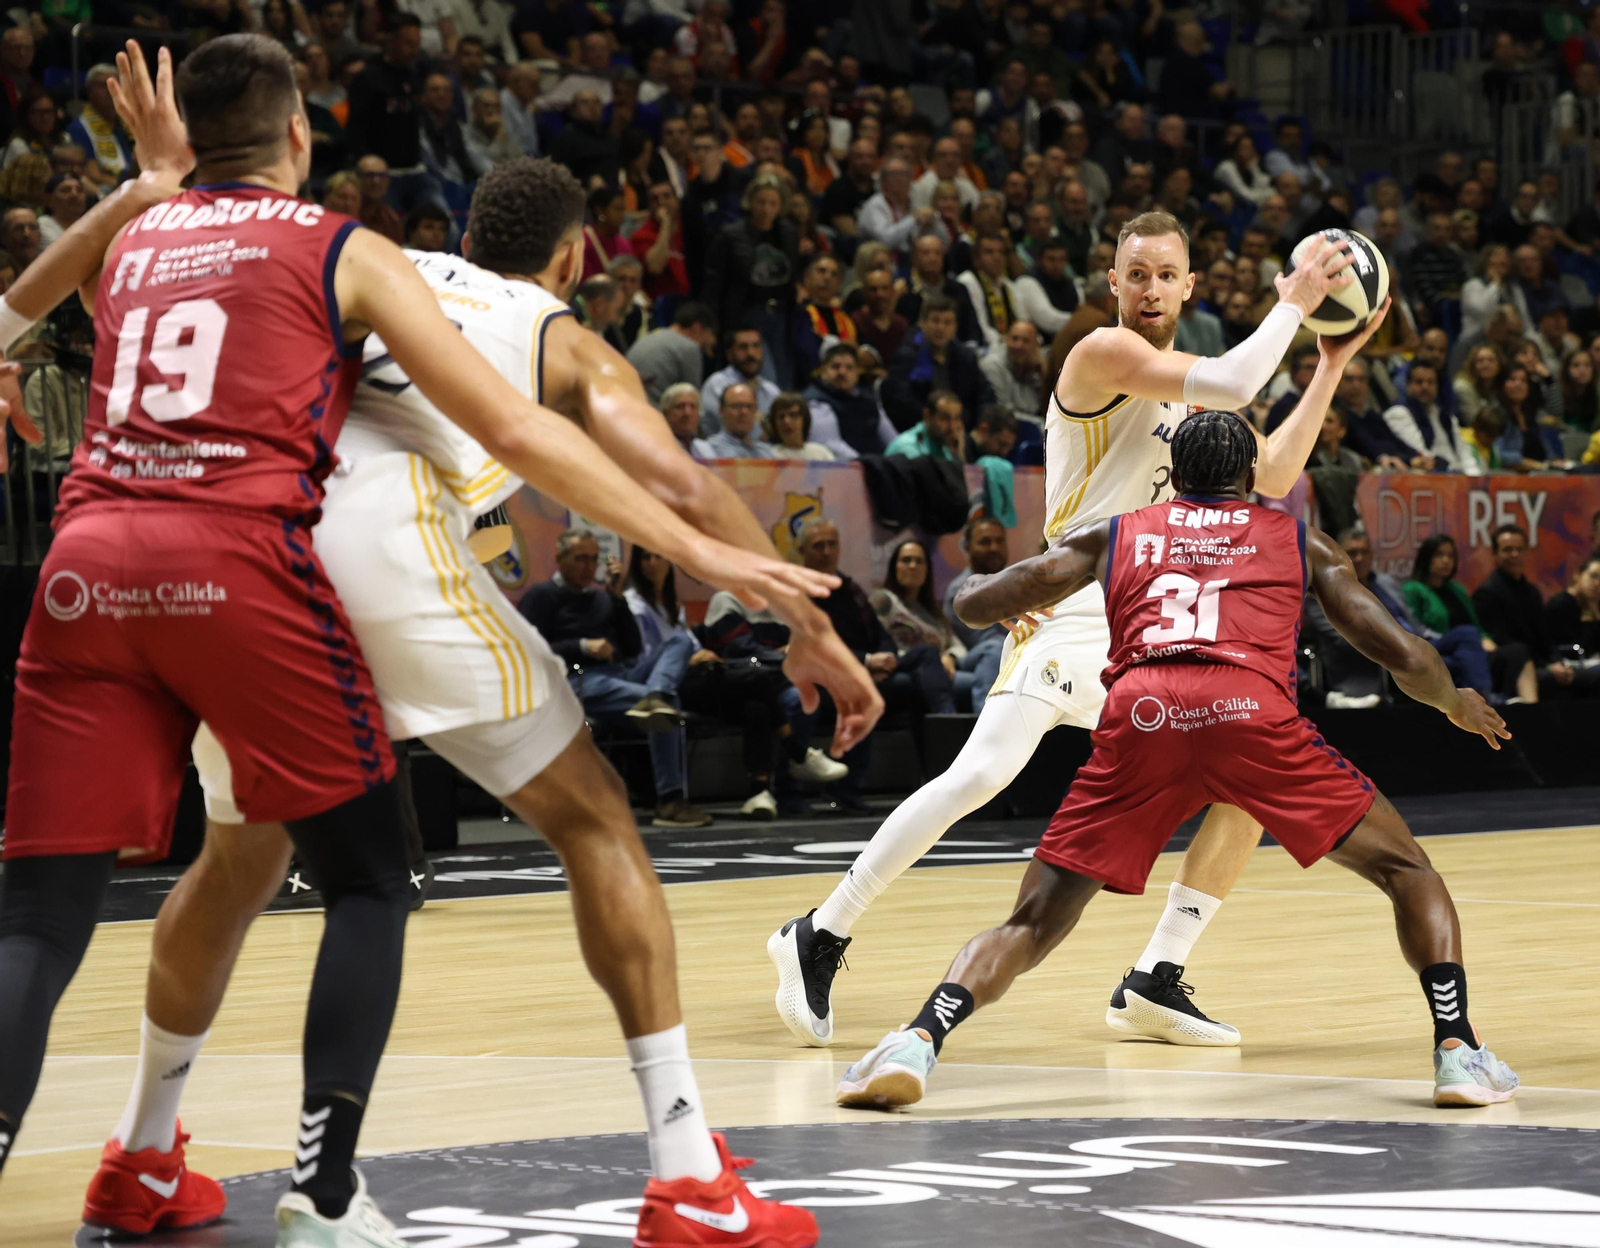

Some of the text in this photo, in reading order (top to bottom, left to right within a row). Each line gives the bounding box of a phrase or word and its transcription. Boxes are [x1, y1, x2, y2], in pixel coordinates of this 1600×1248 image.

[106, 298, 228, 427] 19
[111, 436, 247, 459] Ayuntamiento
[110, 459, 205, 479] de Murcia
[1167, 507, 1250, 529] ENNIS
[1468, 489, 1548, 548] REY
[1169, 544, 1257, 556] DE LA CRUZ 2024
[1171, 536, 1231, 546] CARAVACA
[1168, 555, 1234, 566] AÑO JUBILAR
[92, 580, 227, 602] Costa Cálida
[1141, 573, 1231, 644] 31
[1168, 697, 1260, 720] Costa Cálida
[1170, 711, 1251, 732] Región de Murcia
